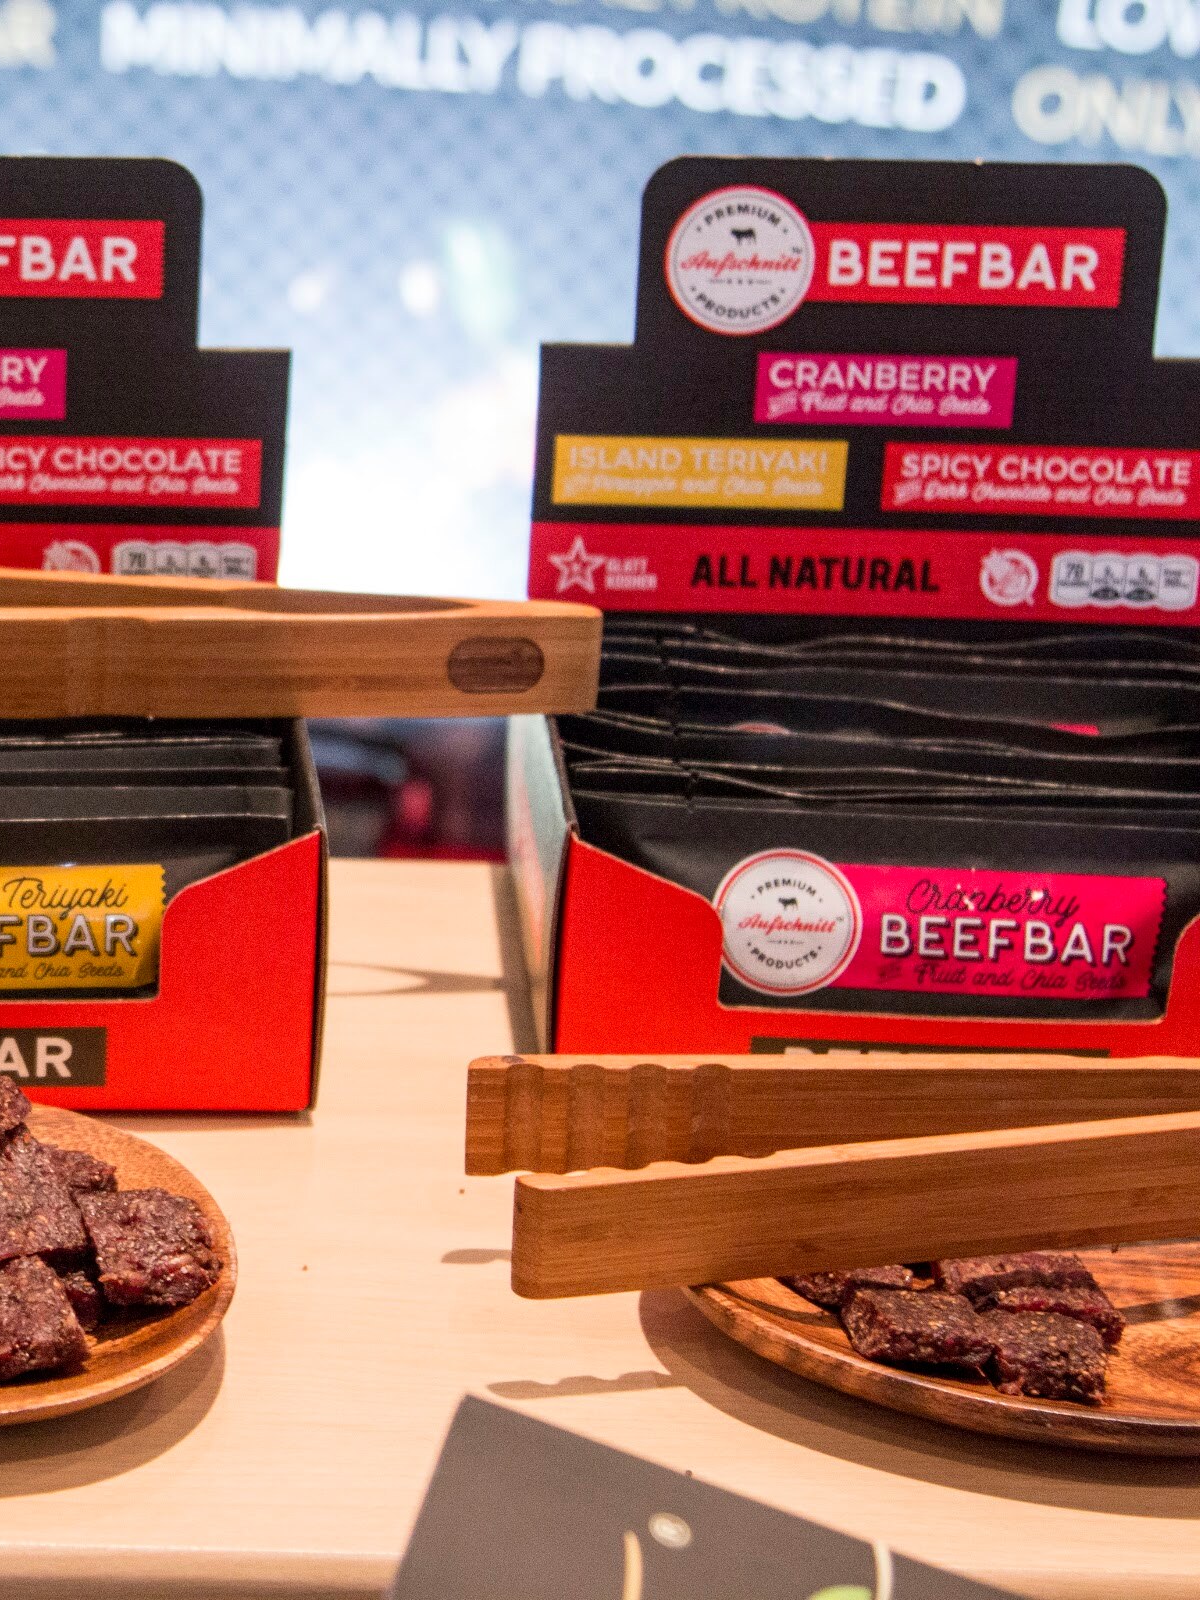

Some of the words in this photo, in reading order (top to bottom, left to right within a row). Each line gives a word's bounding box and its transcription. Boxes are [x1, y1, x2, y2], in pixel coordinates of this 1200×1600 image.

[100, 3, 516, 95] MINIMALLY
[516, 20, 968, 133] PROCESSED
[704, 204, 781, 226] PREMIUM
[680, 249, 802, 278] Aufschnitt
[827, 240, 1099, 292] BEEFBAR
[696, 293, 780, 319] PRODUCTS
[768, 359, 997, 393] CRANBERRY
[53, 448, 242, 474] CHOCOLATE
[569, 446, 682, 472] ISLAND
[692, 448, 828, 473] TERIYAKI
[901, 453, 991, 480] SPICY
[998, 456, 1192, 486] CHOCOLATE
[690, 554, 759, 588] ALL
[769, 555, 941, 592] NATURAL
[2, 877, 129, 921] Teriyaki
[757, 878, 817, 896] PREMIUM
[906, 879, 1081, 928] Cranberry
[737, 913, 837, 936] Aufschnitt
[879, 913, 1136, 967] BEEFBAR
[33, 963, 72, 979] Chia
[750, 947, 819, 970] PRODUCTS
[972, 968, 1015, 987] and
[1019, 969, 1068, 990] Chia
